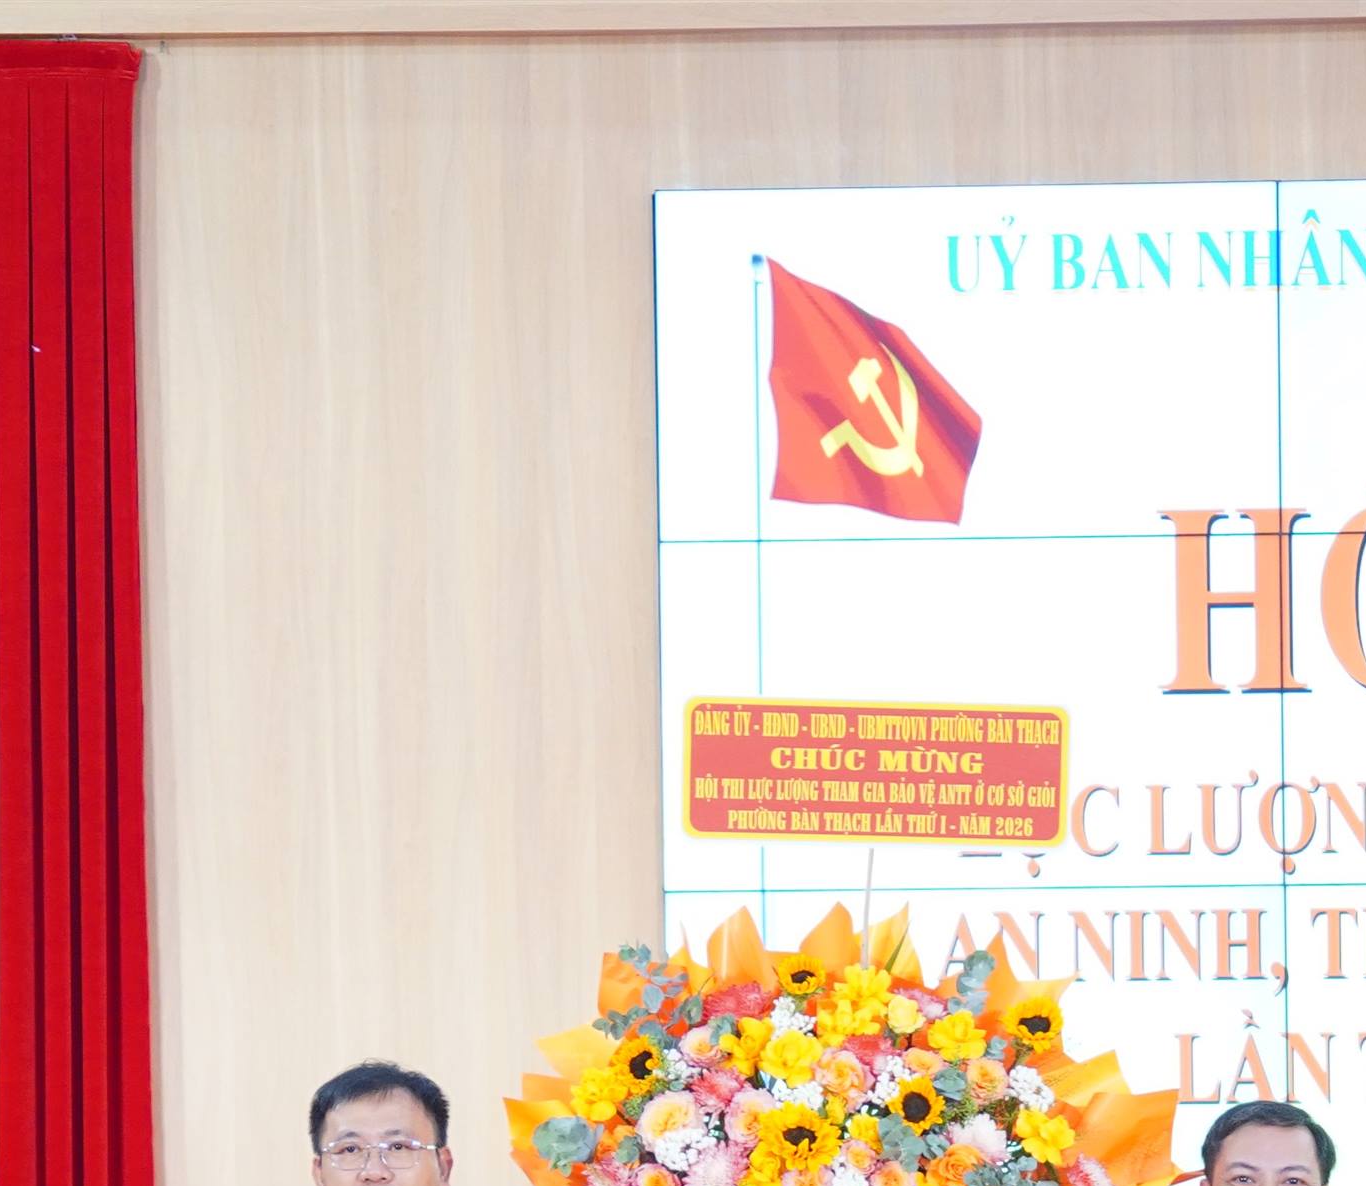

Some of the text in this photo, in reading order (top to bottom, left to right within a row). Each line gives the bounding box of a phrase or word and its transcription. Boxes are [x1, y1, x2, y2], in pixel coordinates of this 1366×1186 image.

[945, 214, 1028, 294] UỶ
[1050, 231, 1173, 292] BAN
[694, 703, 731, 736] ĐẢNG
[762, 711, 799, 738] HĐND
[810, 713, 846, 739] UBND
[857, 714, 927, 743] UBMTTQVN
[930, 711, 984, 743] PHƯỜNG
[987, 713, 1014, 744] BÀN
[1016, 719, 1060, 748] THẠCH
[770, 744, 984, 774] CHÚC MỪNG
[694, 773, 718, 803] HỘI
[721, 778, 744, 799] THI
[748, 776, 773, 804] LỰC
[776, 777, 819, 805] LƯỢNG
[822, 780, 860, 802] THAM
[862, 781, 885, 803] GIA
[889, 776, 915, 804] BẢO
[919, 778, 936, 809] VỆ
[938, 783, 973, 805] ANTT
[1027, 780, 1056, 808] GIỎI
[727, 806, 787, 831] PHƯỜNG
[790, 807, 820, 832] BÀN
[823, 811, 871, 835] THẠCH
[906, 810, 938, 835] THỨ
[939, 814, 947, 835] I
[958, 812, 992, 836] NĂM
[995, 816, 1034, 837] 2026
[937, 910, 1047, 982] AN
[1068, 907, 1289, 996] NINH,
[1174, 1007, 1337, 1105] LẦN
